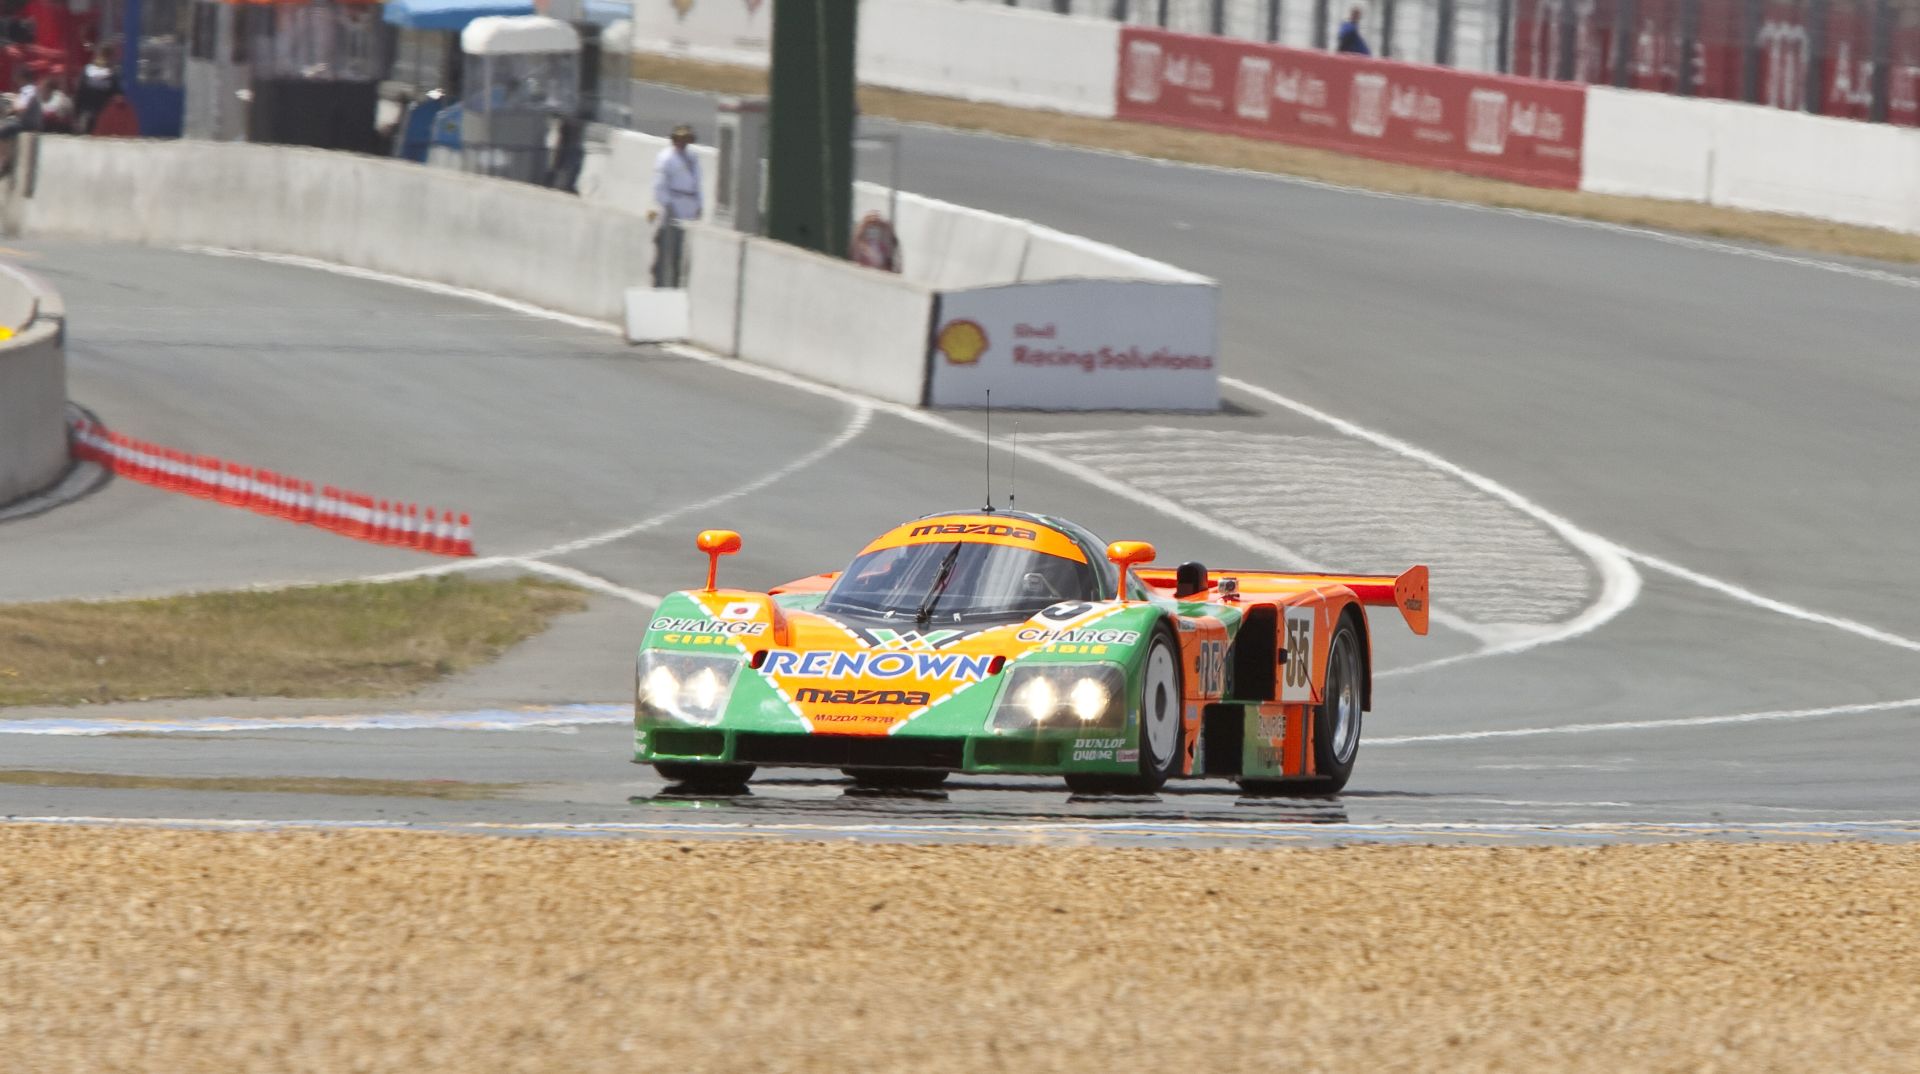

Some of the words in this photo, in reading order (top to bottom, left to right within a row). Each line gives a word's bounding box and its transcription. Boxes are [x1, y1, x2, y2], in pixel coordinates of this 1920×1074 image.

[1013, 346, 1096, 372] Racing
[1099, 346, 1213, 370] Solutions
[649, 617, 769, 636] CHARGE
[1016, 628, 1140, 646] CHARGE
[1285, 618, 1310, 688] 55
[762, 651, 992, 681] RENOWN
[1074, 738, 1126, 748] DUNLOP
